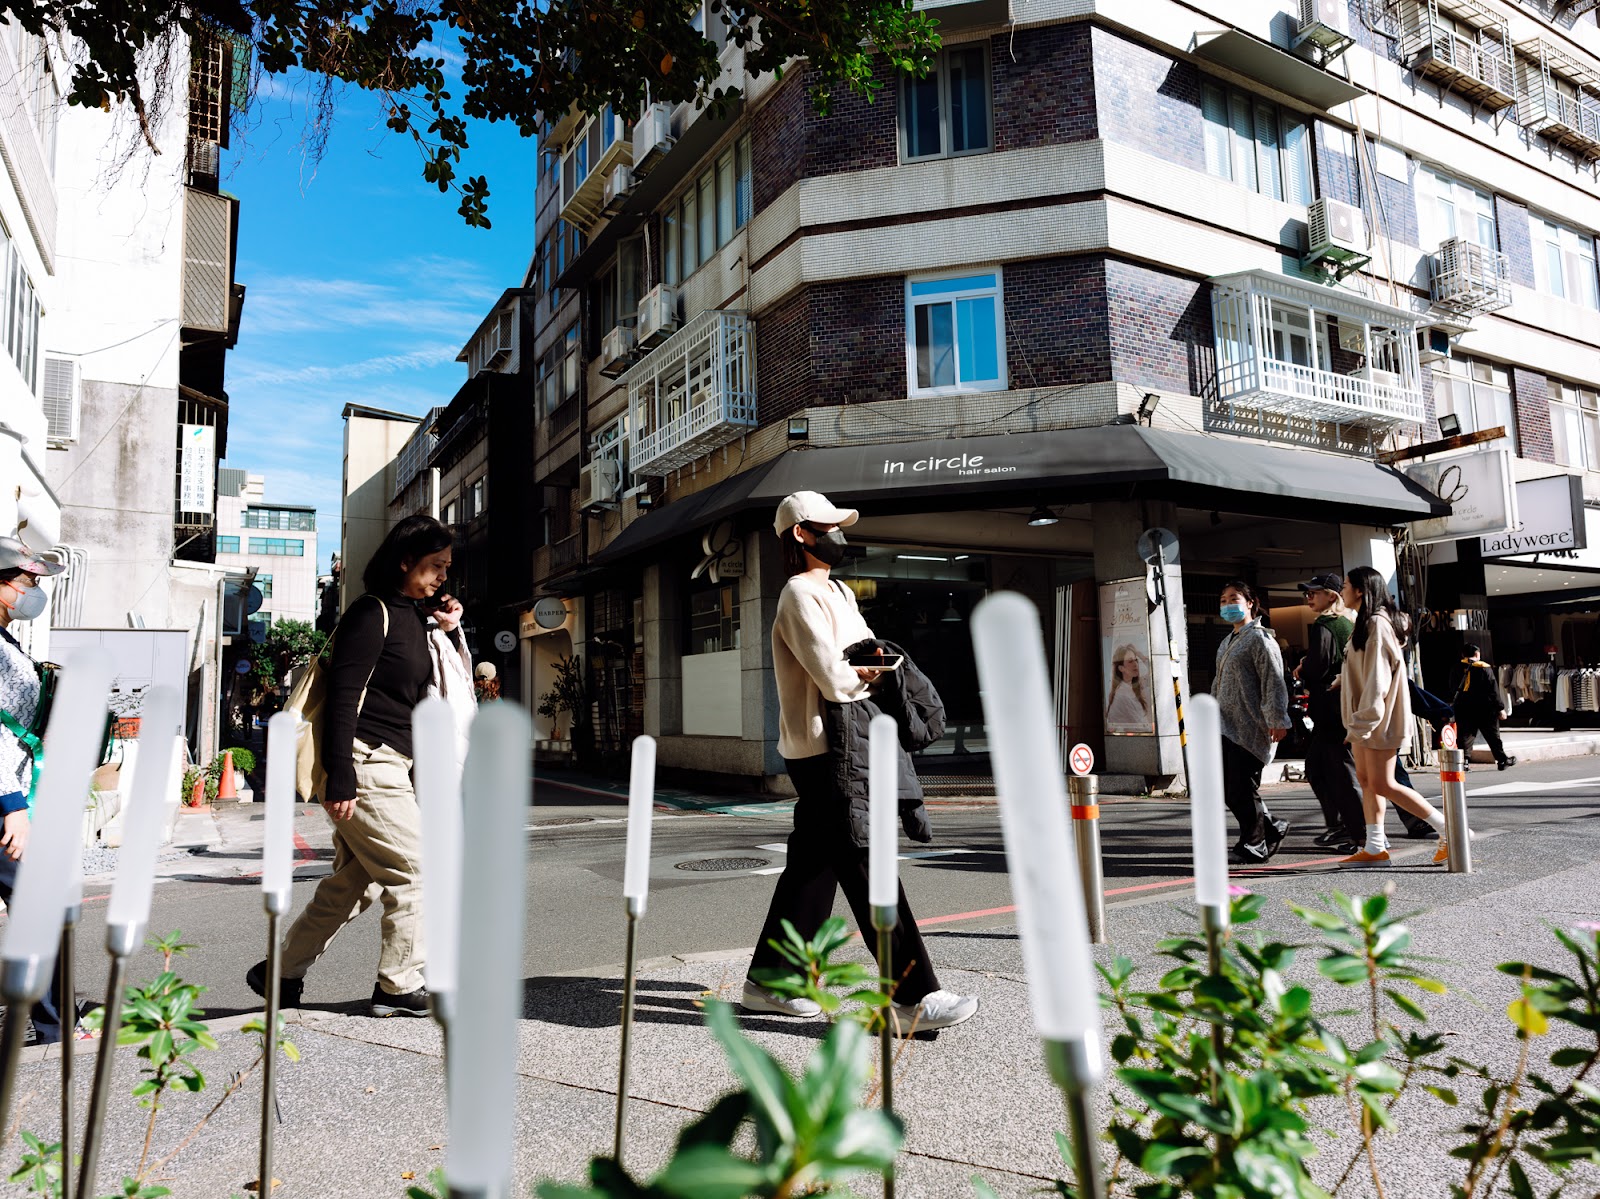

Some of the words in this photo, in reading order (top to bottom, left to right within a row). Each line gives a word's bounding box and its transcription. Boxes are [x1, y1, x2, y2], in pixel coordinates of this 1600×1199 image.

[884, 460, 904, 474] in
[912, 453, 984, 471] circle
[984, 466, 1017, 474] salon
